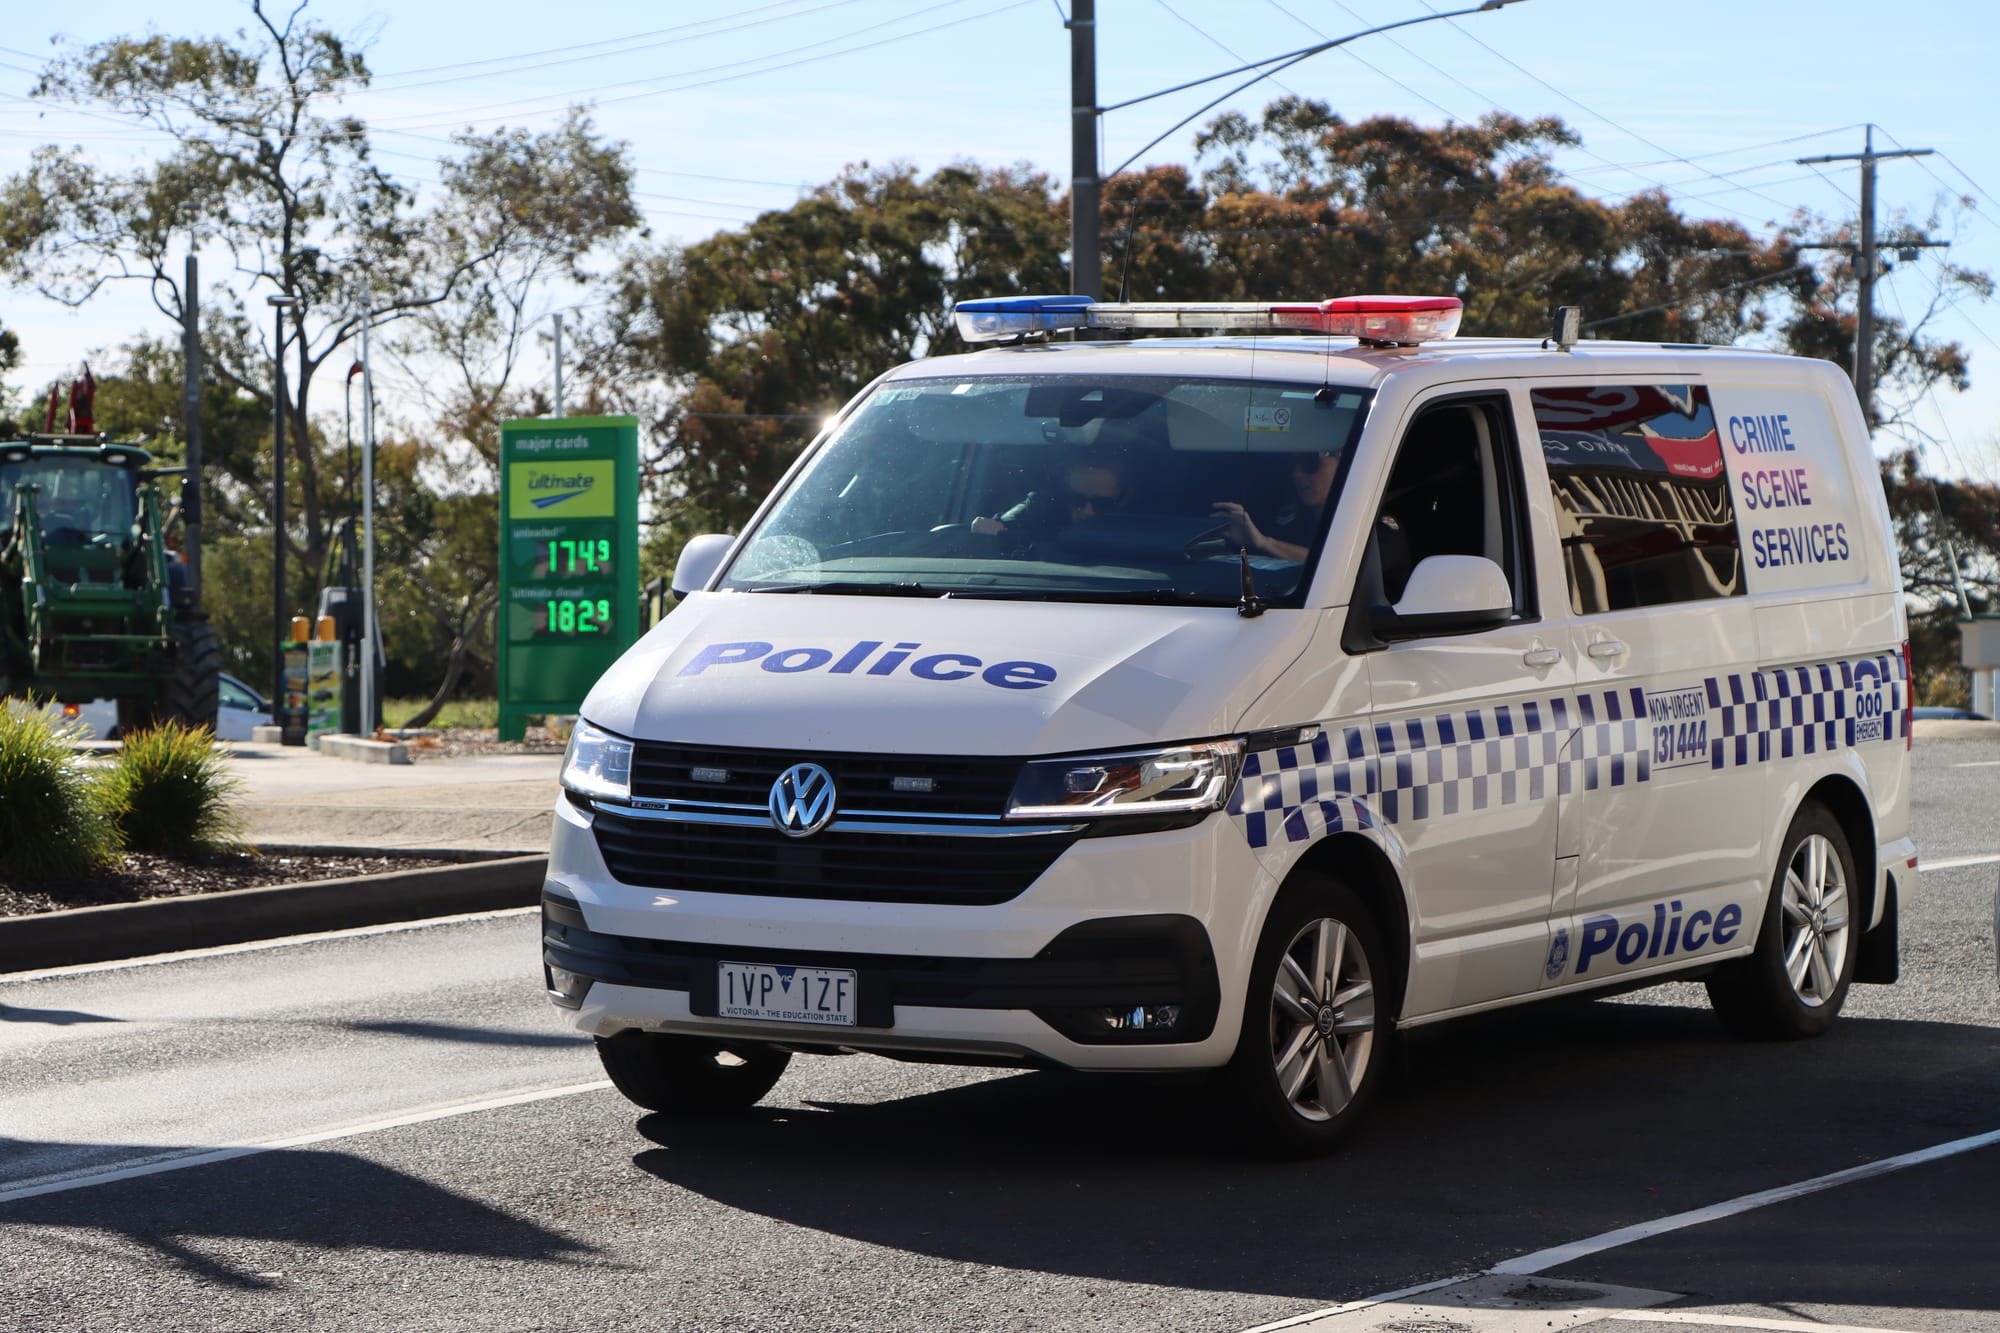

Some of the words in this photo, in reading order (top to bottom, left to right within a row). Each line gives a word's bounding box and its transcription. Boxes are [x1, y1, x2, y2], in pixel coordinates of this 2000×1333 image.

[515, 437, 551, 453] major
[554, 434, 590, 450] cards
[1729, 414, 1796, 454] CRIME
[527, 474, 595, 490] ultimate
[1741, 468, 1812, 511] SCENE
[1752, 522, 1850, 569] SERVICES
[676, 641, 1058, 690] Police
[1648, 692, 1706, 723] NON-URGENT
[1856, 692, 1883, 719] 000
[1856, 720, 1883, 740] EMERGENCY
[1575, 900, 1742, 974] Police
[727, 971, 774, 1007] 1VP
[802, 976, 849, 1012] 1ZF
[726, 1007, 760, 1017] VICTORIA
[766, 1010, 781, 1018] THE
[783, 1011, 824, 1021] EDUCATION
[825, 1014, 848, 1023] STATE
